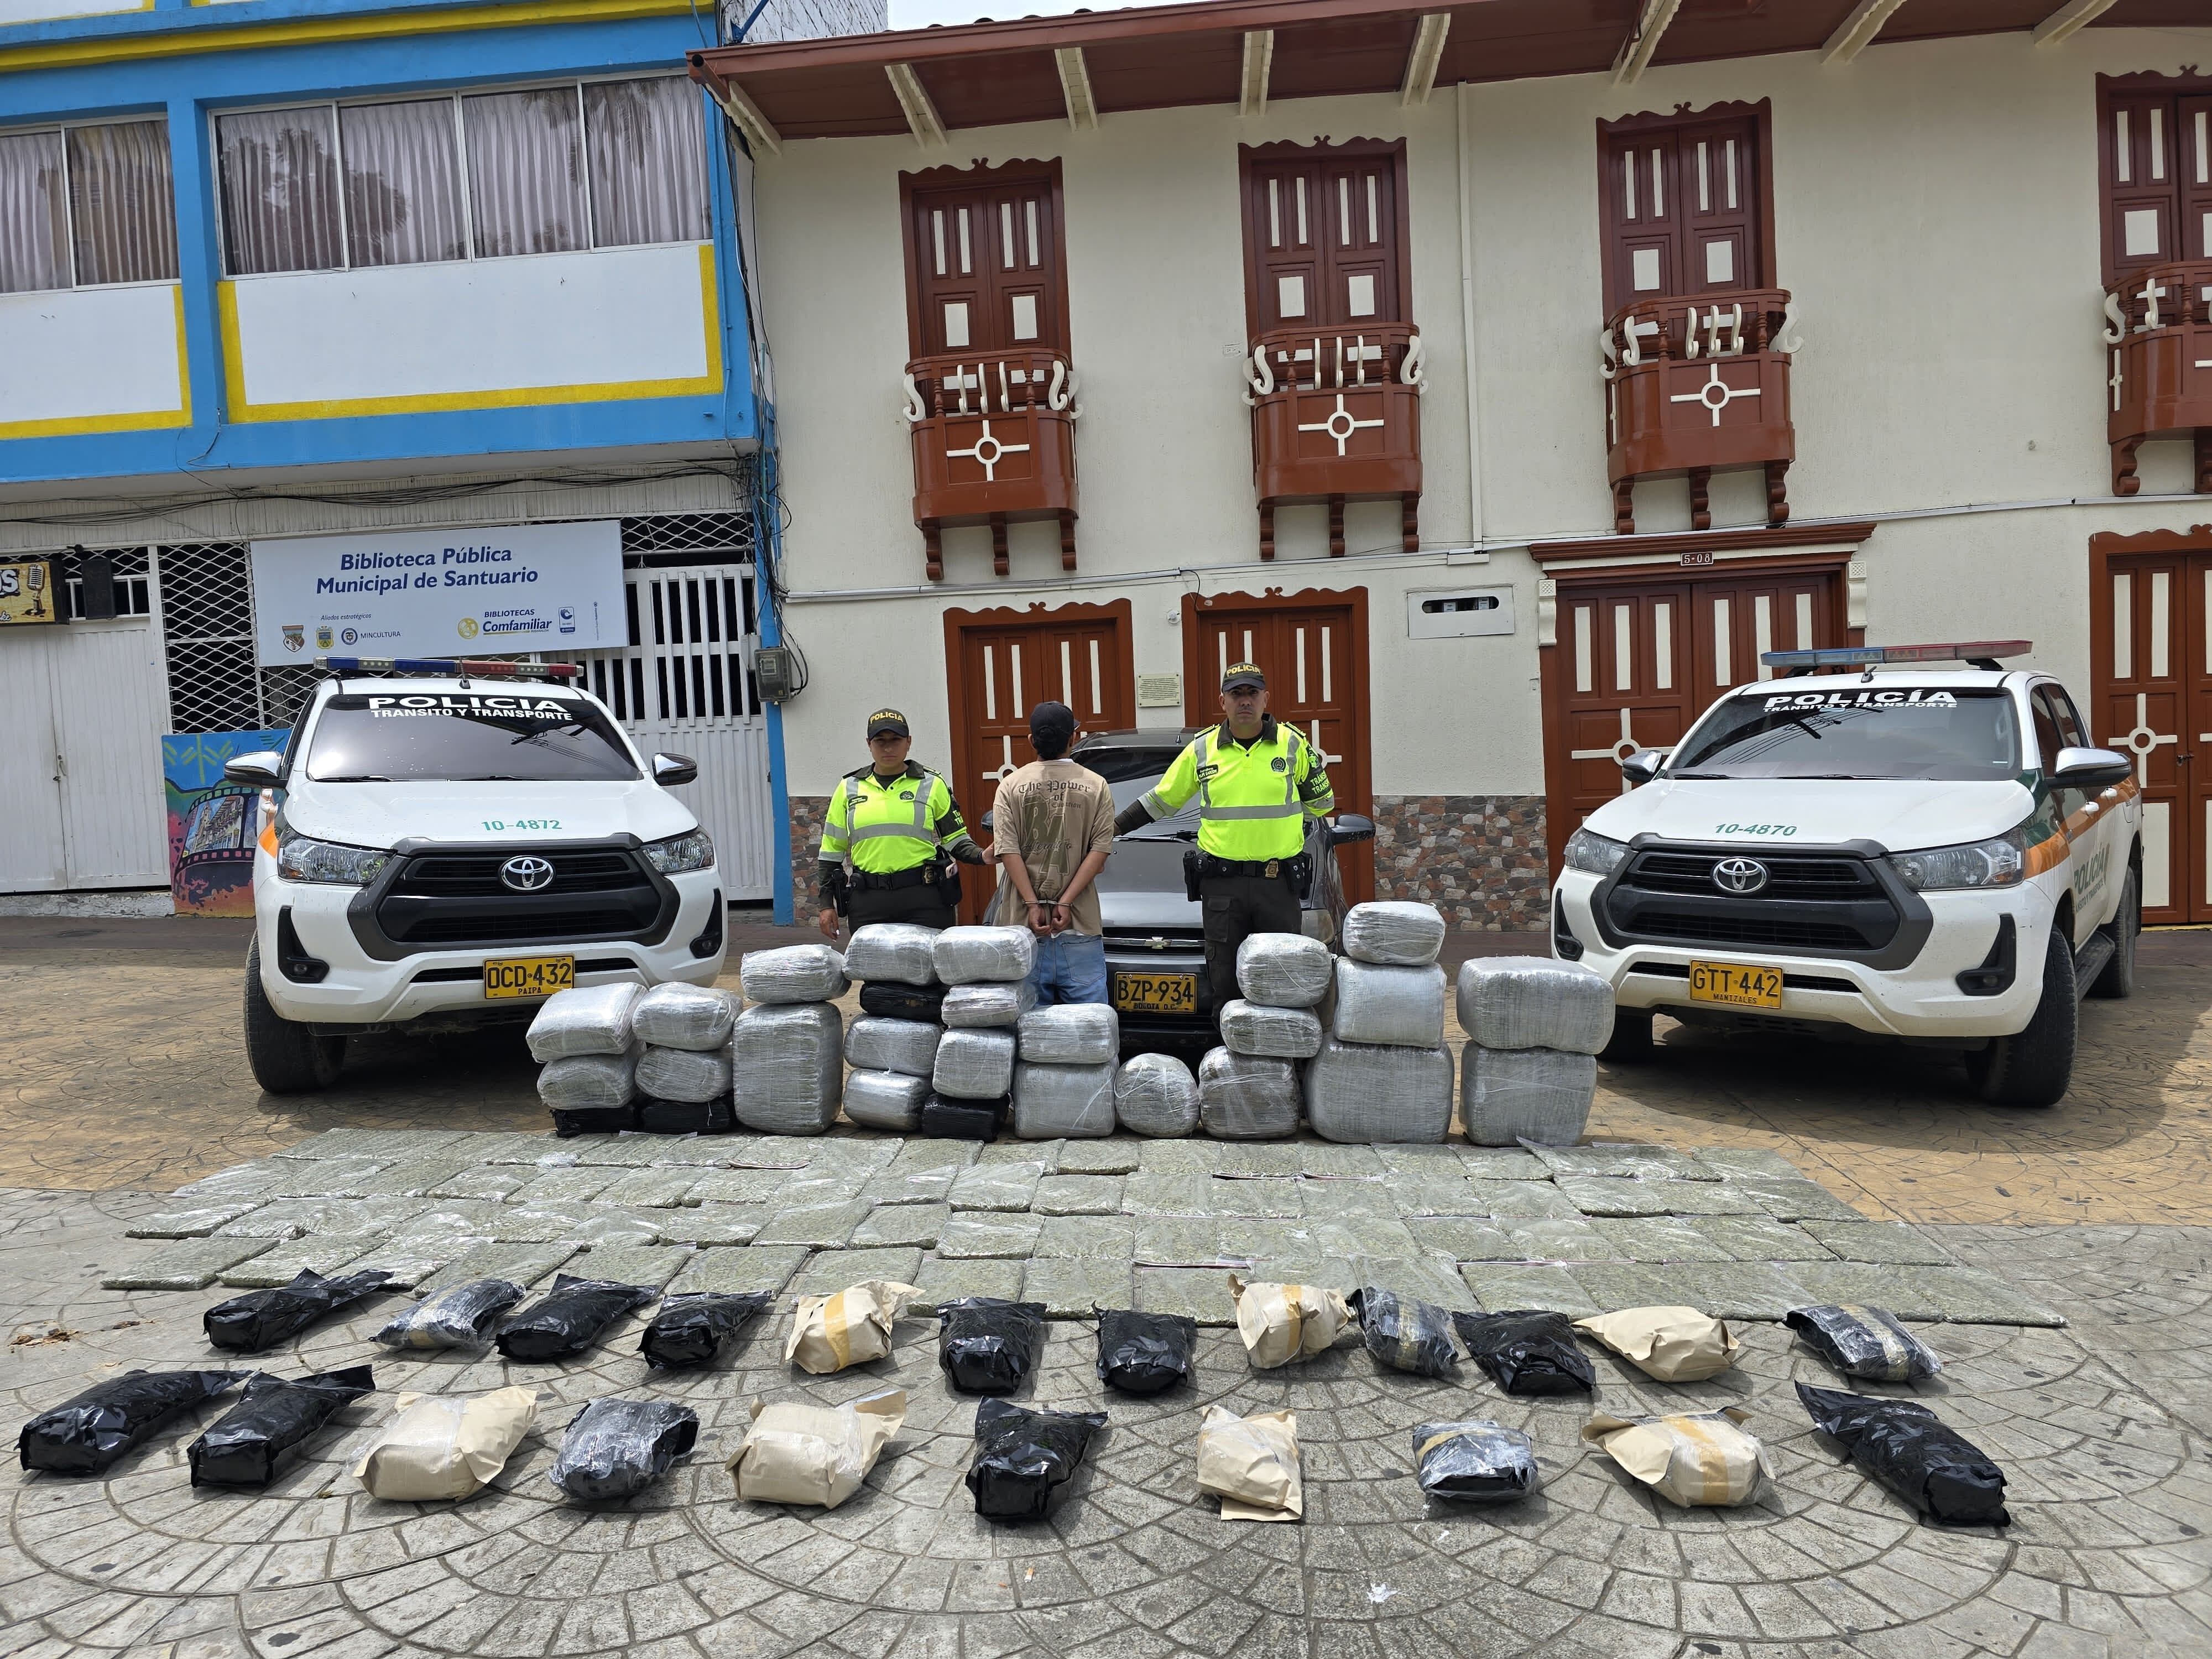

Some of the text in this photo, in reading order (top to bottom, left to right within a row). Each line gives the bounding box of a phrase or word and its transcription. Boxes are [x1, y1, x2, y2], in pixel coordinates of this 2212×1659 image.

[341, 546, 512, 570] Biblioteca Pública
[1684, 553, 1710, 564] 5-08
[317, 567, 538, 595] Municipal de Santuario
[484, 609, 535, 618] BIBLIOTECAS
[483, 618, 552, 632] Comfamiliar
[1227, 664, 1261, 677] POLICIA
[368, 696, 568, 712] POLICIA
[1765, 690, 1958, 708] POLICÍA
[371, 708, 452, 718] TRANSITO
[471, 708, 573, 721] TRANSPORTE
[870, 712, 904, 724] POLICIA
[1018, 780, 1091, 794] The Power
[1054, 792, 1066, 801] of
[481, 820, 562, 831] 10-4872
[1715, 823, 1797, 836] 10-4870
[518, 987, 542, 995] PAIPA
[1714, 993, 1757, 1004] MANIZALES
